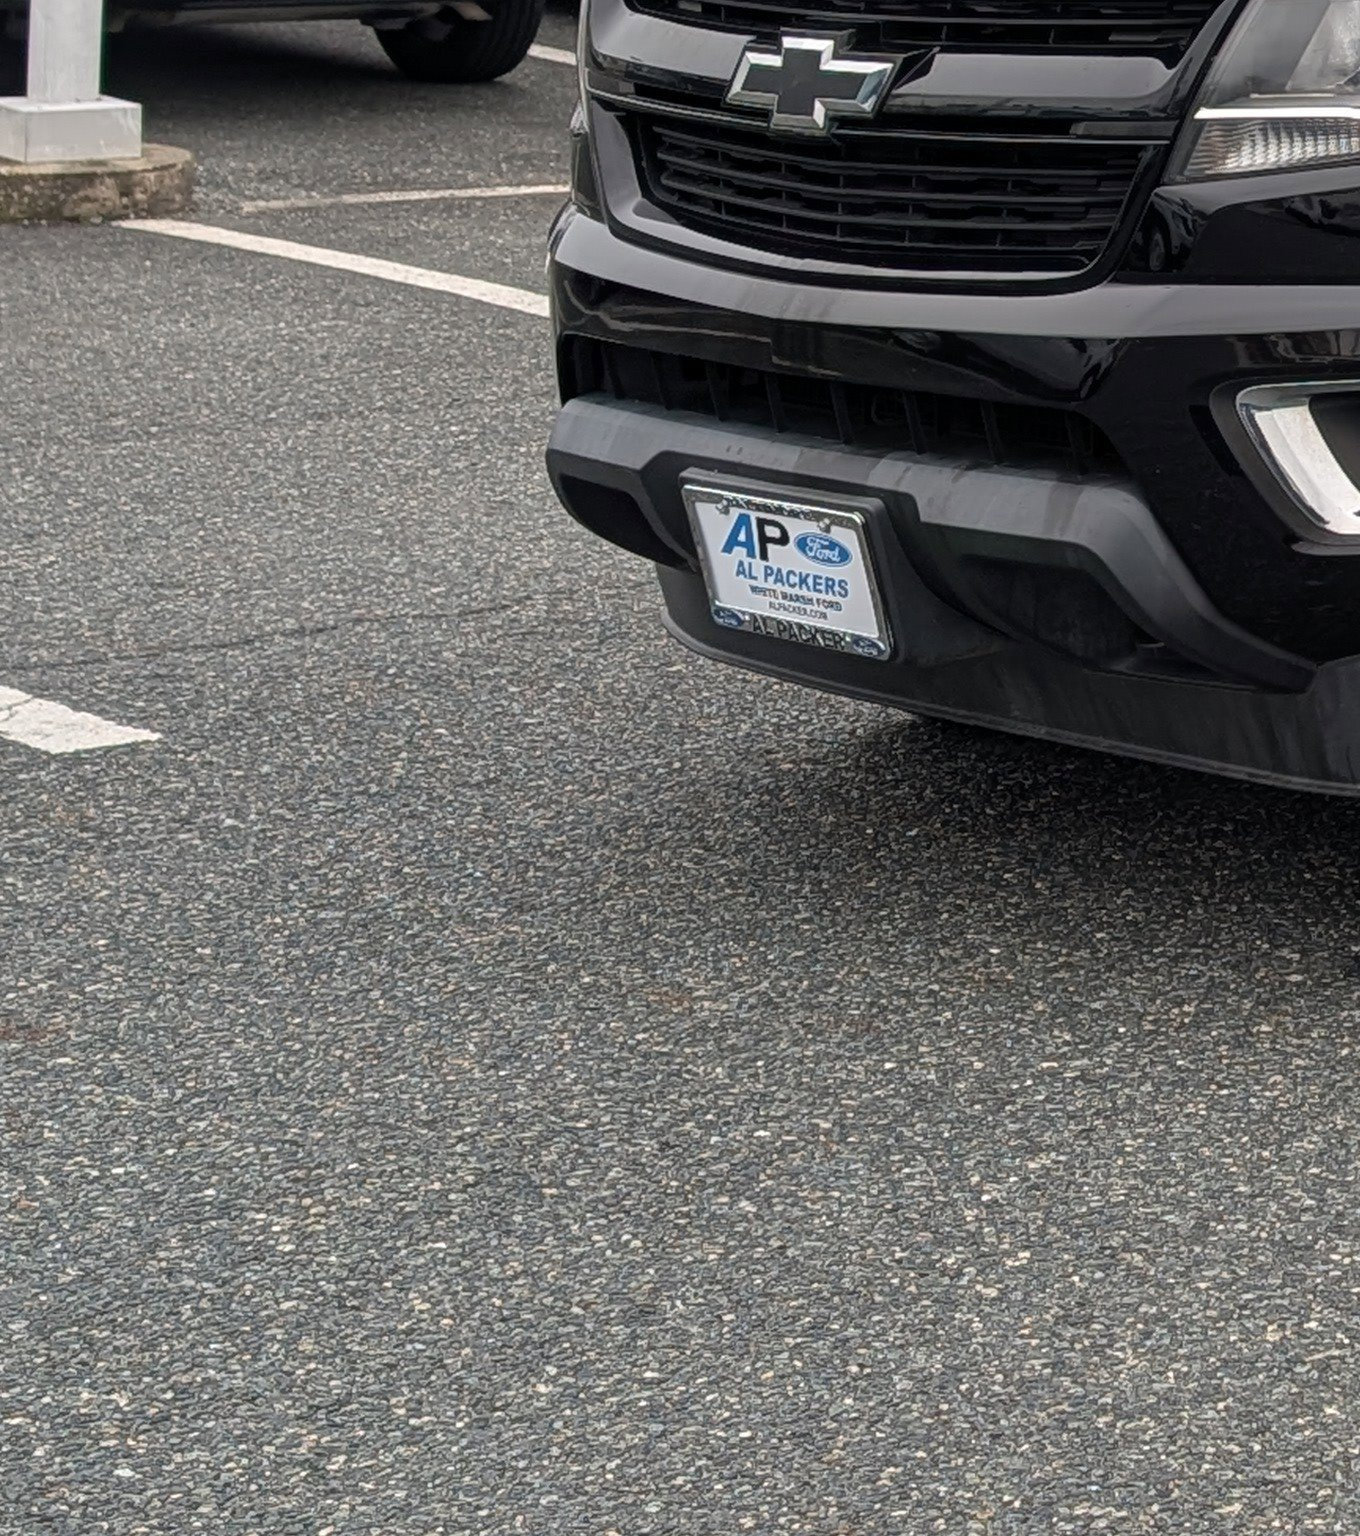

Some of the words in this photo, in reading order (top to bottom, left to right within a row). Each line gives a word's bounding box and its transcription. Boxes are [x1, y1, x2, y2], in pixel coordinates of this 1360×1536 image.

[720, 512, 790, 562] AP
[805, 536, 842, 563] Ford
[735, 560, 758, 581] AL
[763, 565, 849, 599] PACKERS
[752, 615, 774, 634] AL
[777, 619, 845, 651] PACKER
